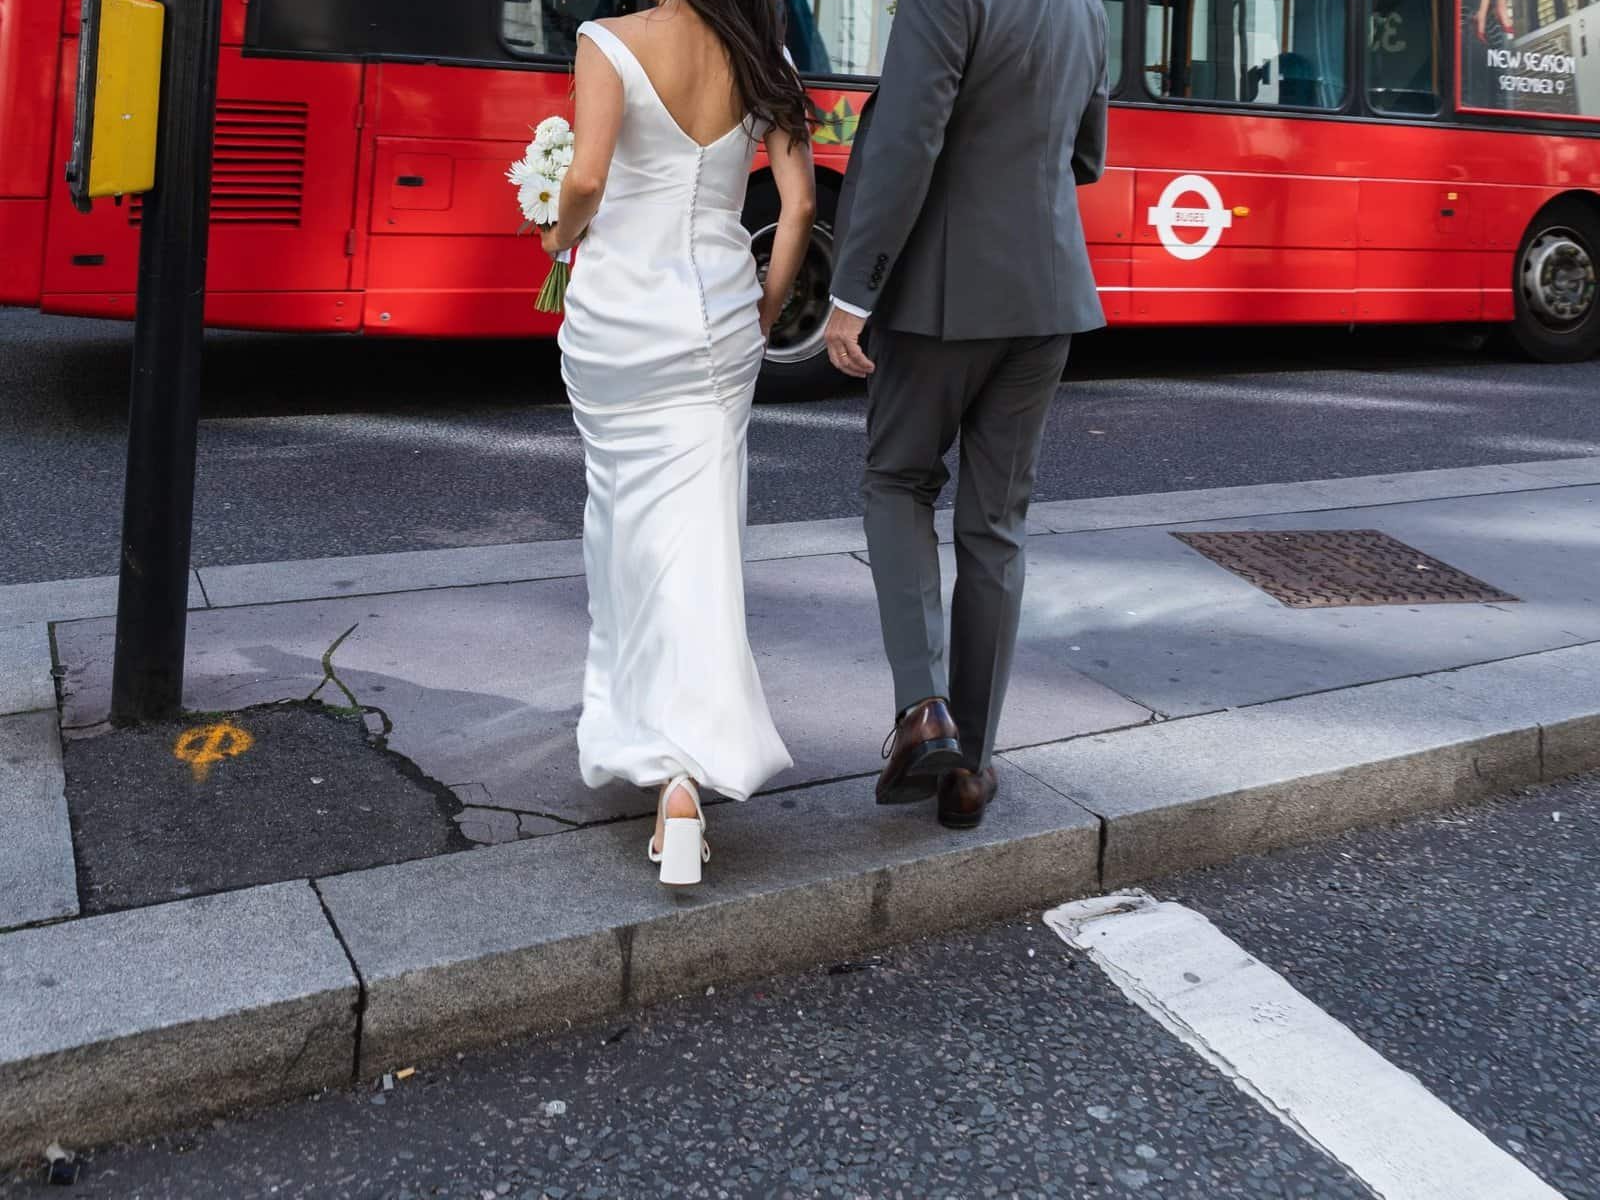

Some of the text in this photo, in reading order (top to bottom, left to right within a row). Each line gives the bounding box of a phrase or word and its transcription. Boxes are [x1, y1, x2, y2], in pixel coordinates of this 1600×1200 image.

[1487, 48, 1576, 74] NEW SEASON
[1498, 75, 1565, 95] SEPTEMBER 9
